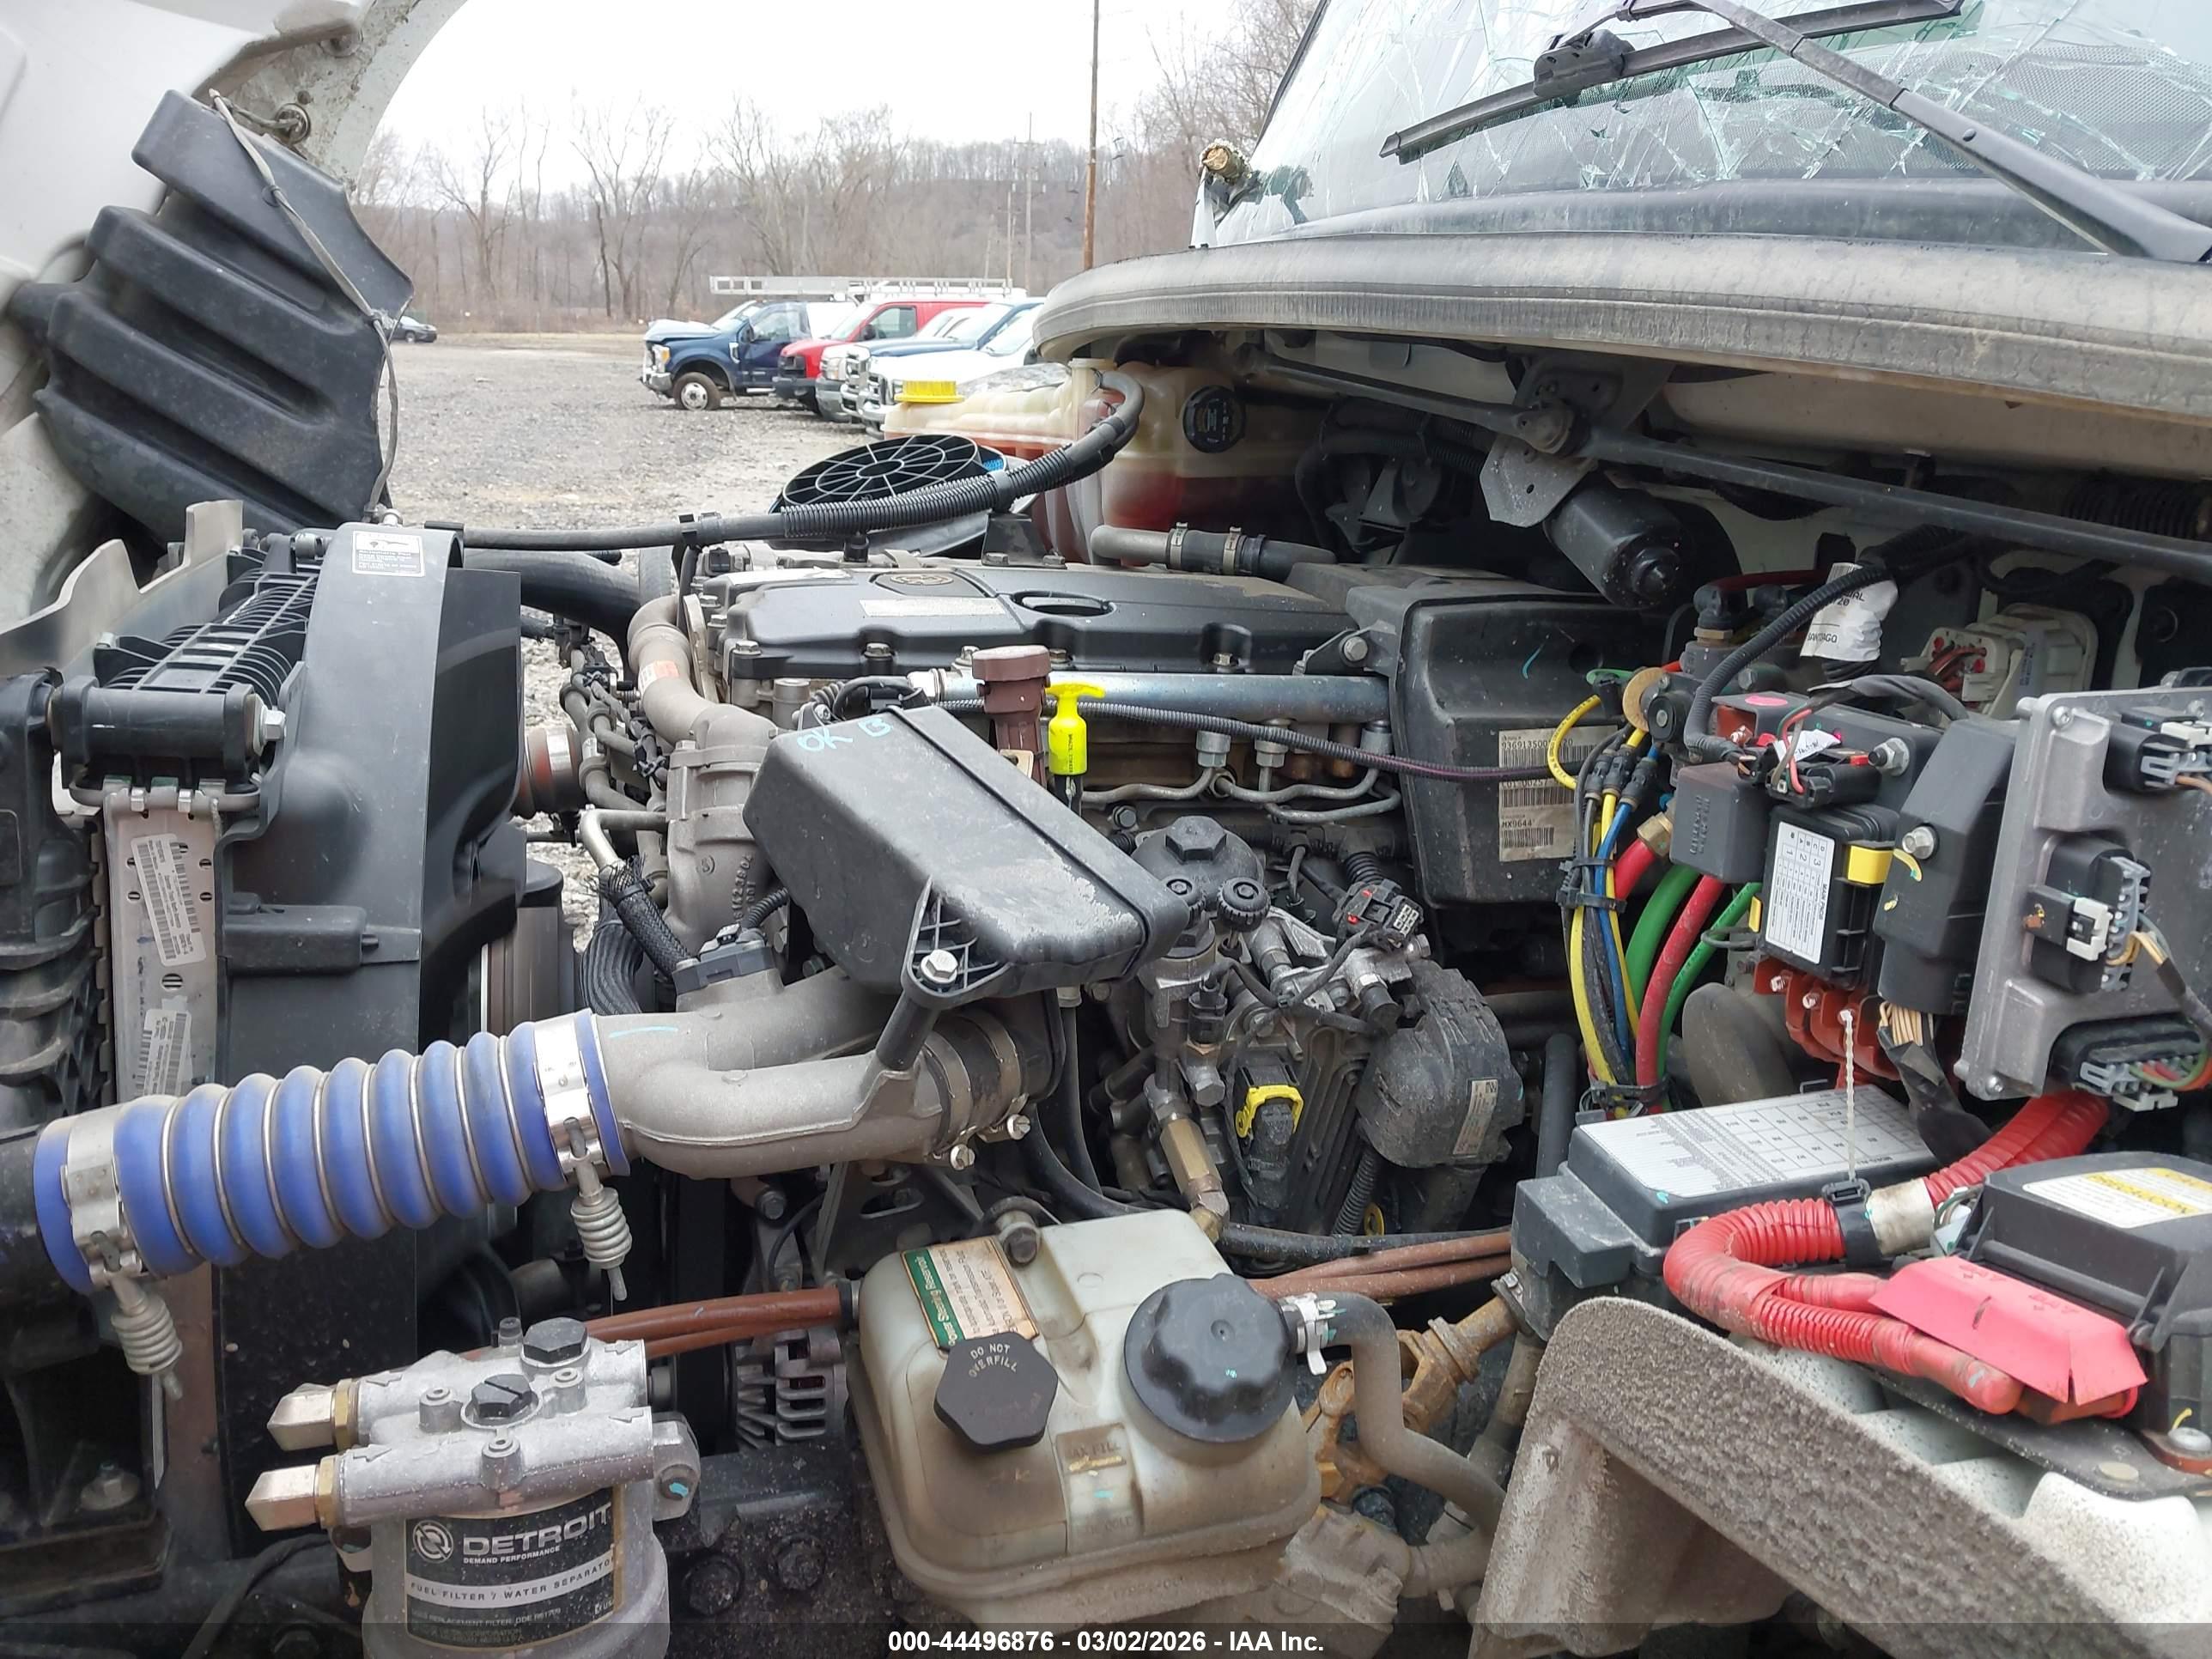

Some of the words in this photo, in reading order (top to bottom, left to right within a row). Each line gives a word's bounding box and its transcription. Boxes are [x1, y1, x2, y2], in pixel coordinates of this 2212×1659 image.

[797, 727, 853, 752] OK
[915, 1255, 937, 1289] Reservoir
[930, 1290, 950, 1322] Steering
[970, 1346, 985, 1360] DO
[989, 1343, 1011, 1354] NOT
[969, 1355, 1018, 1378] OVERFILL
[464, 1503, 611, 1555] DETROIT
[500, 1547, 561, 1563] PERFORMANCE
[410, 1583, 437, 1596] FUEL
[442, 1592, 485, 1601] FILTER
[504, 1584, 547, 1600] WATER
